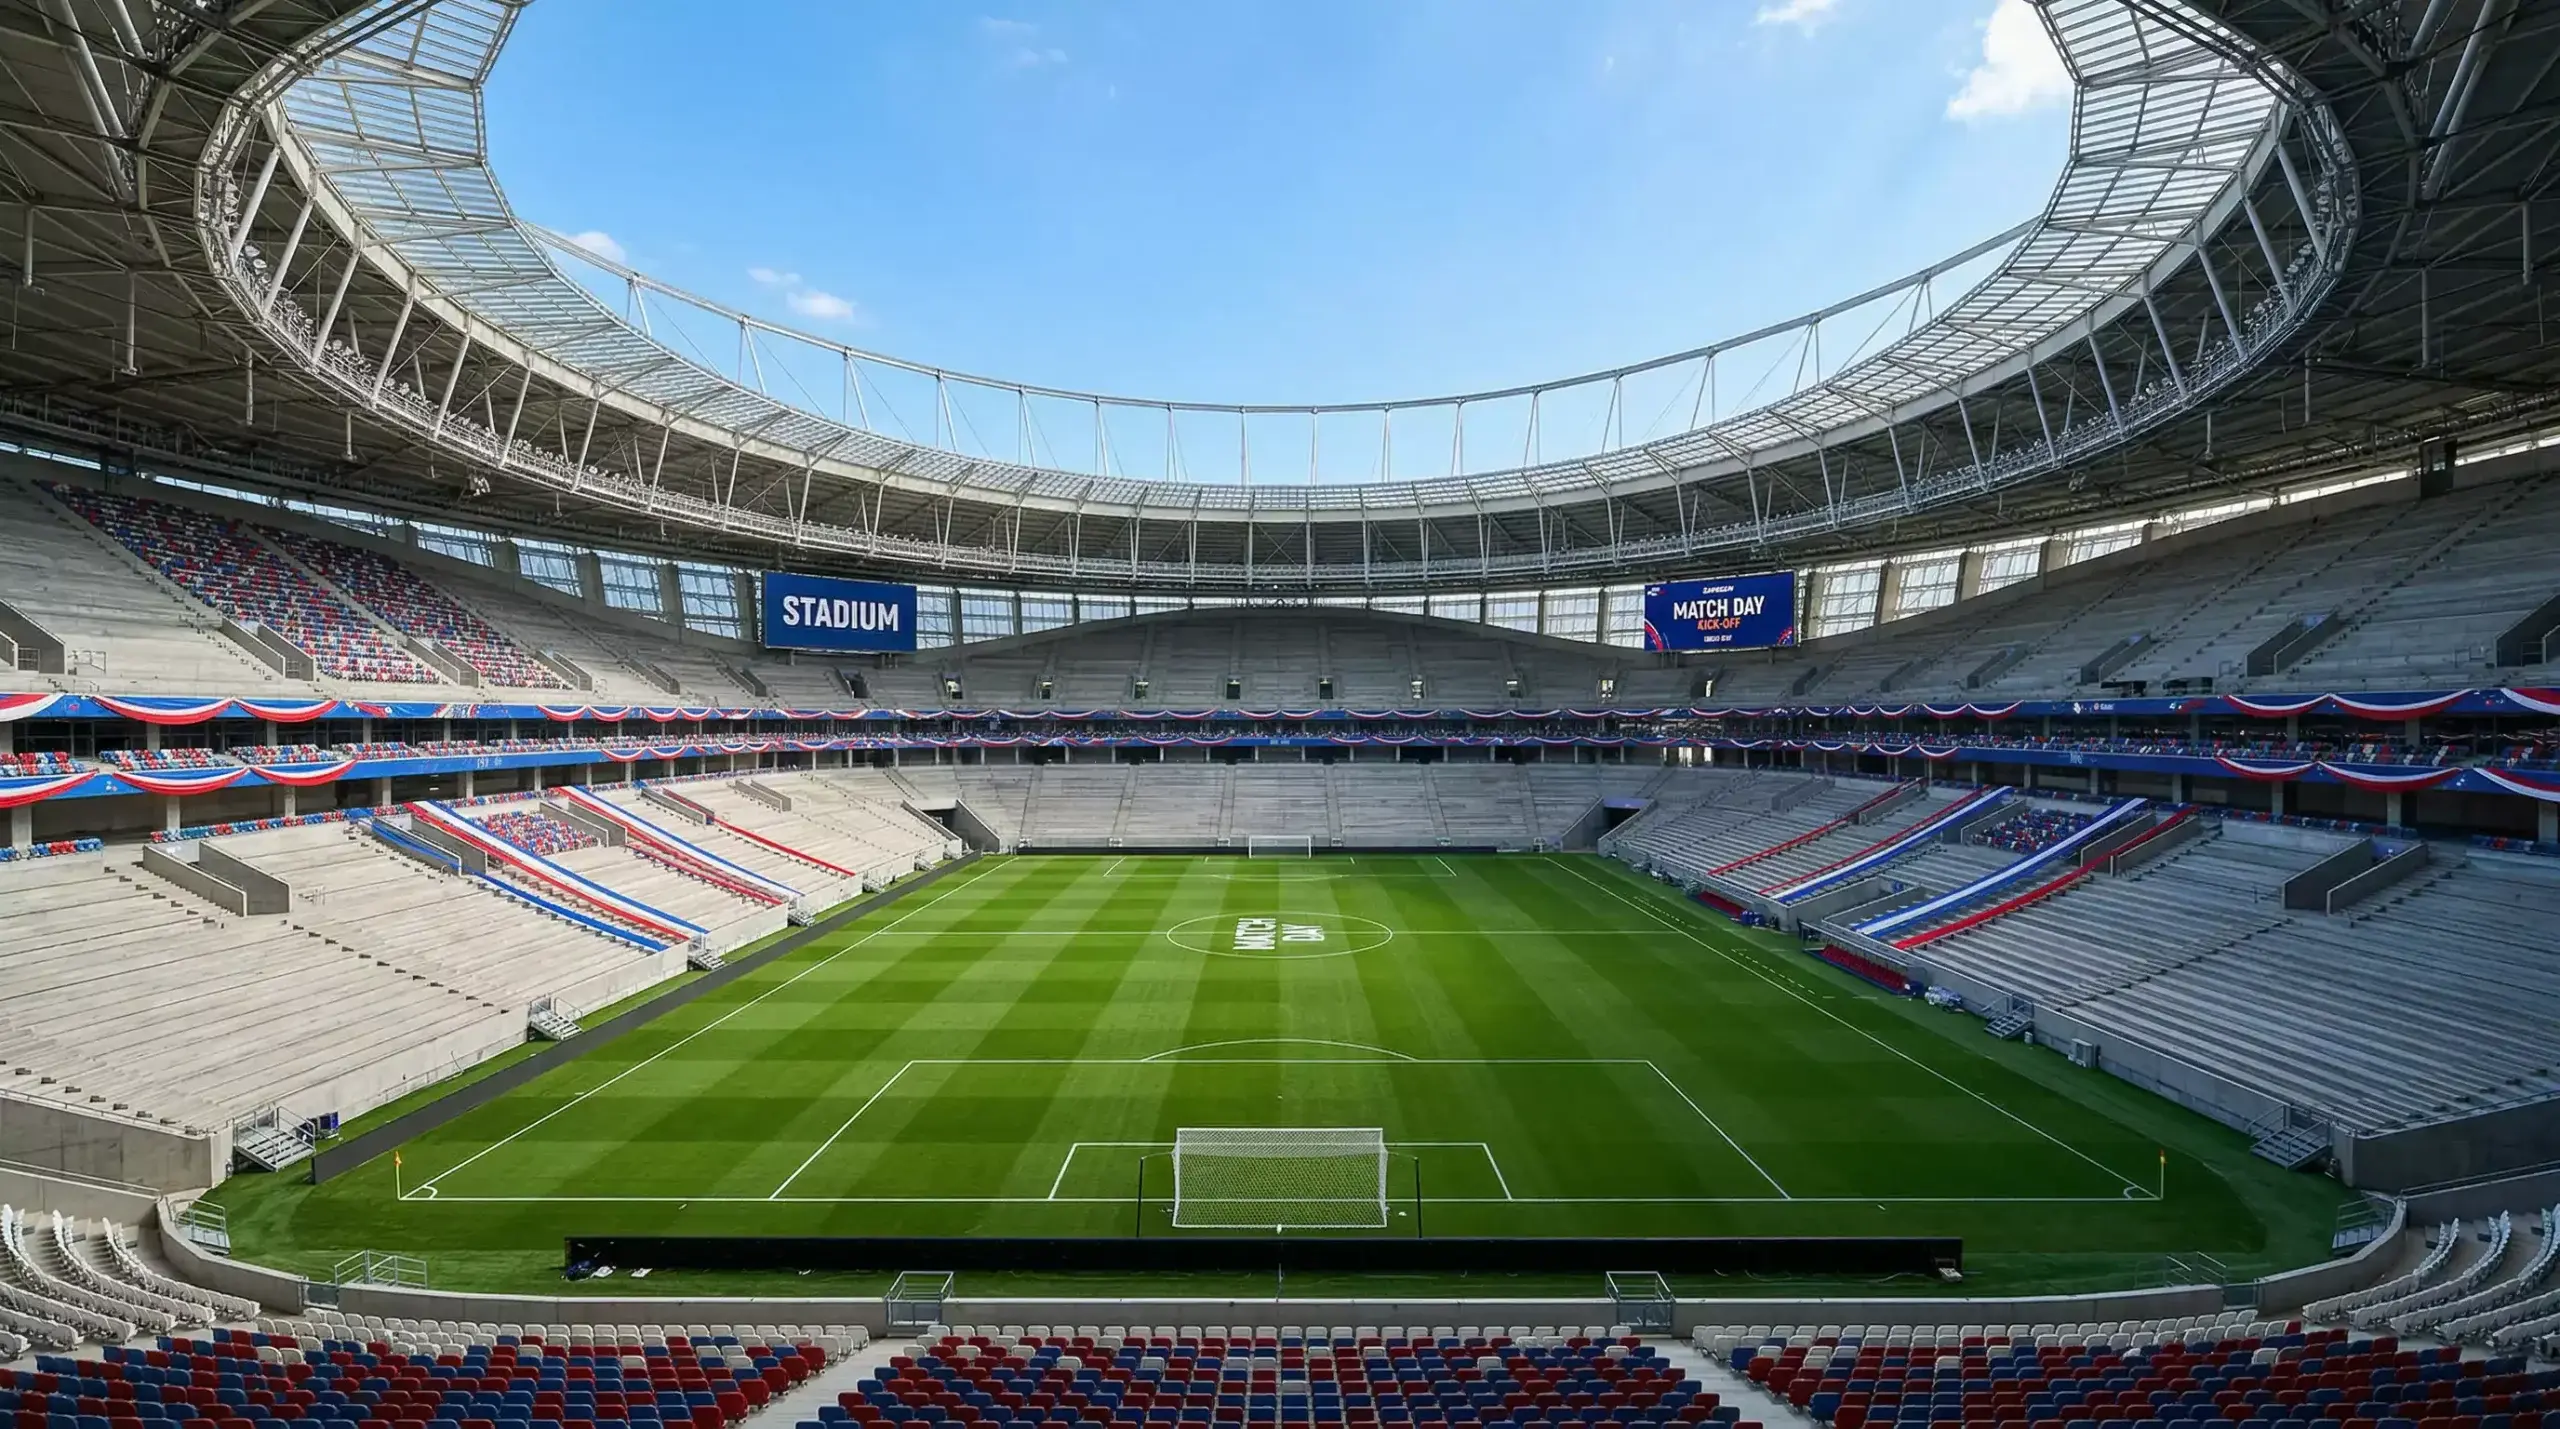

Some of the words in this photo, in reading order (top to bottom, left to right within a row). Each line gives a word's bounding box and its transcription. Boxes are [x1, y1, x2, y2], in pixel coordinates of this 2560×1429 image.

[783, 595, 899, 632] STADIUM
[1673, 598, 1728, 620] MATCH
[1733, 595, 1765, 616] DAY
[1697, 617, 1741, 631] KICK-OFF
